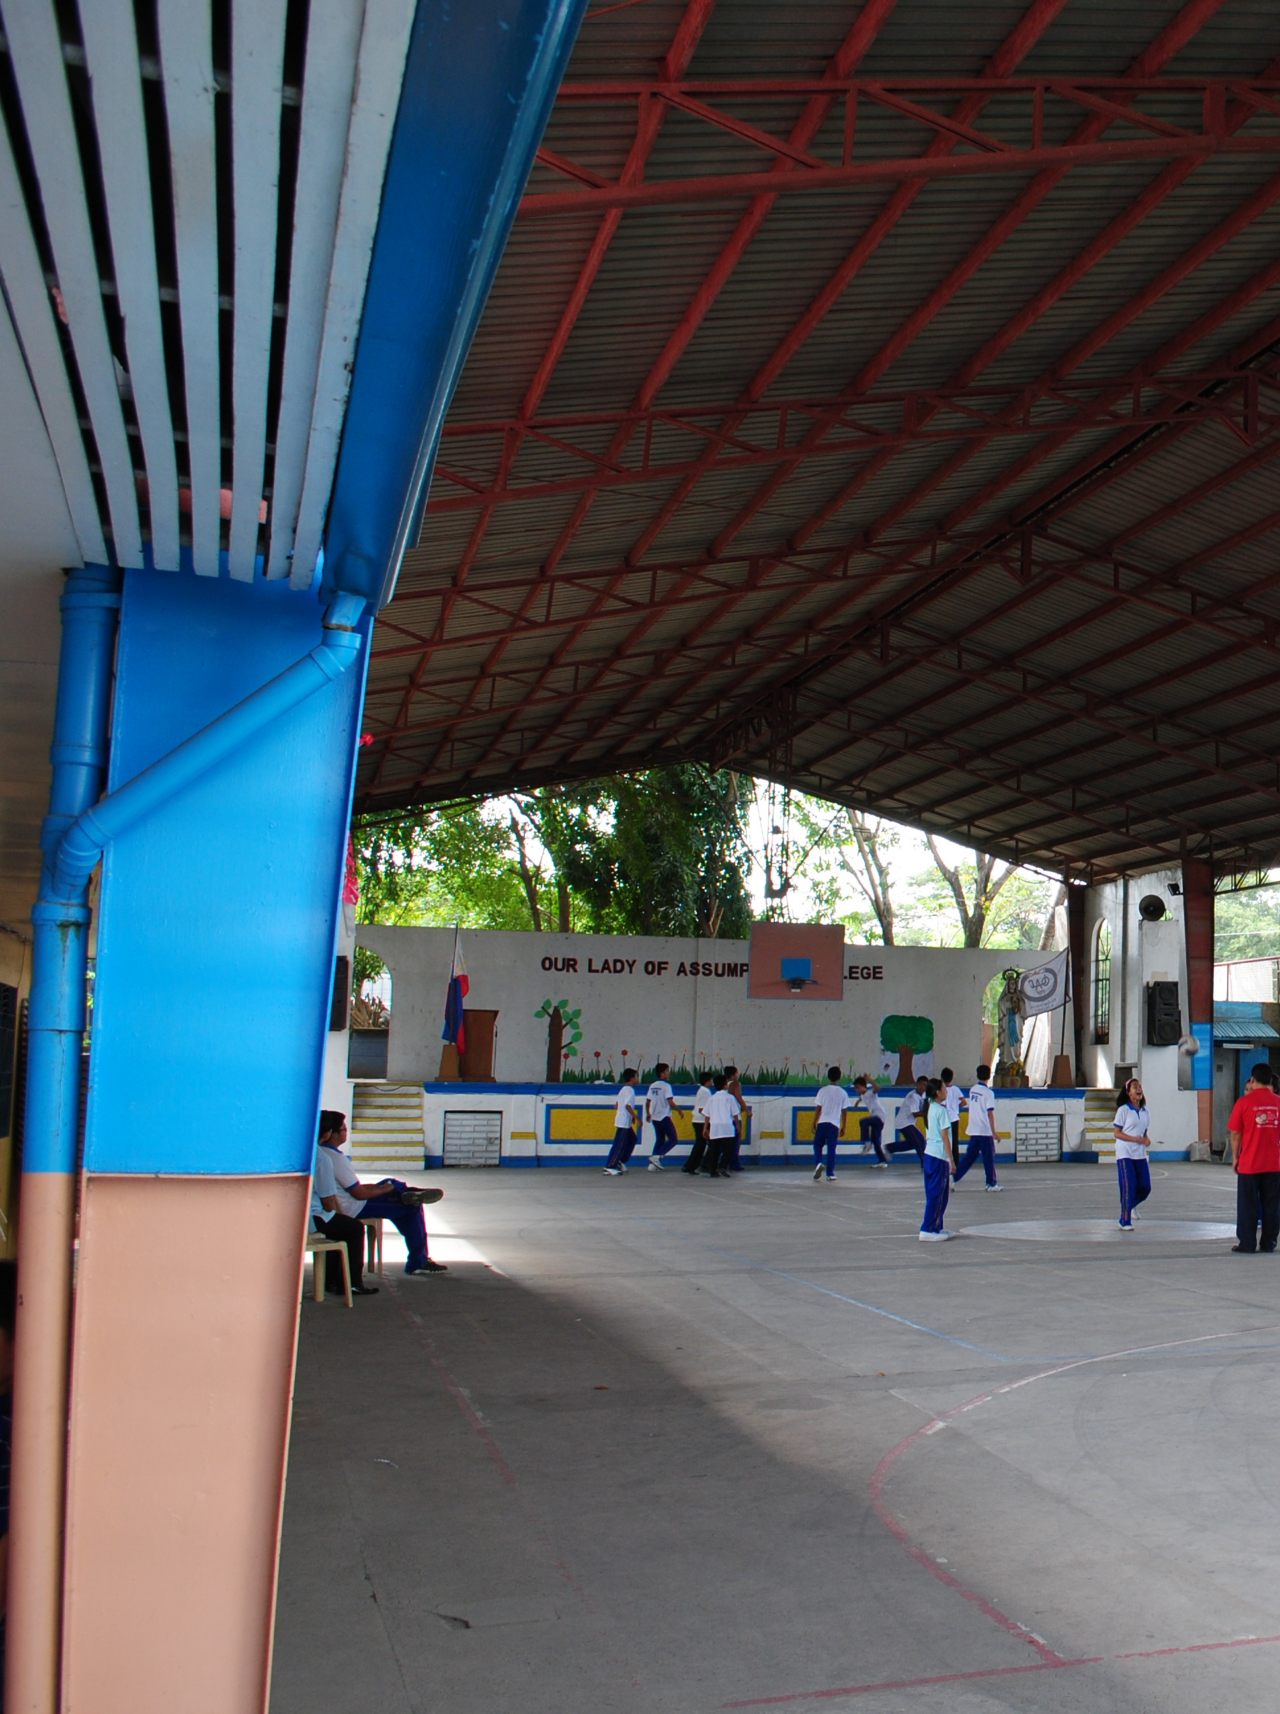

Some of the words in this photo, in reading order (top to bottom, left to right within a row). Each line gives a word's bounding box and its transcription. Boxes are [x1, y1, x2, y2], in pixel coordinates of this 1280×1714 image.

[541, 956, 578, 973] OUR
[588, 958, 638, 975] LADY
[644, 959, 669, 976] OF
[843, 965, 884, 980] EGE
